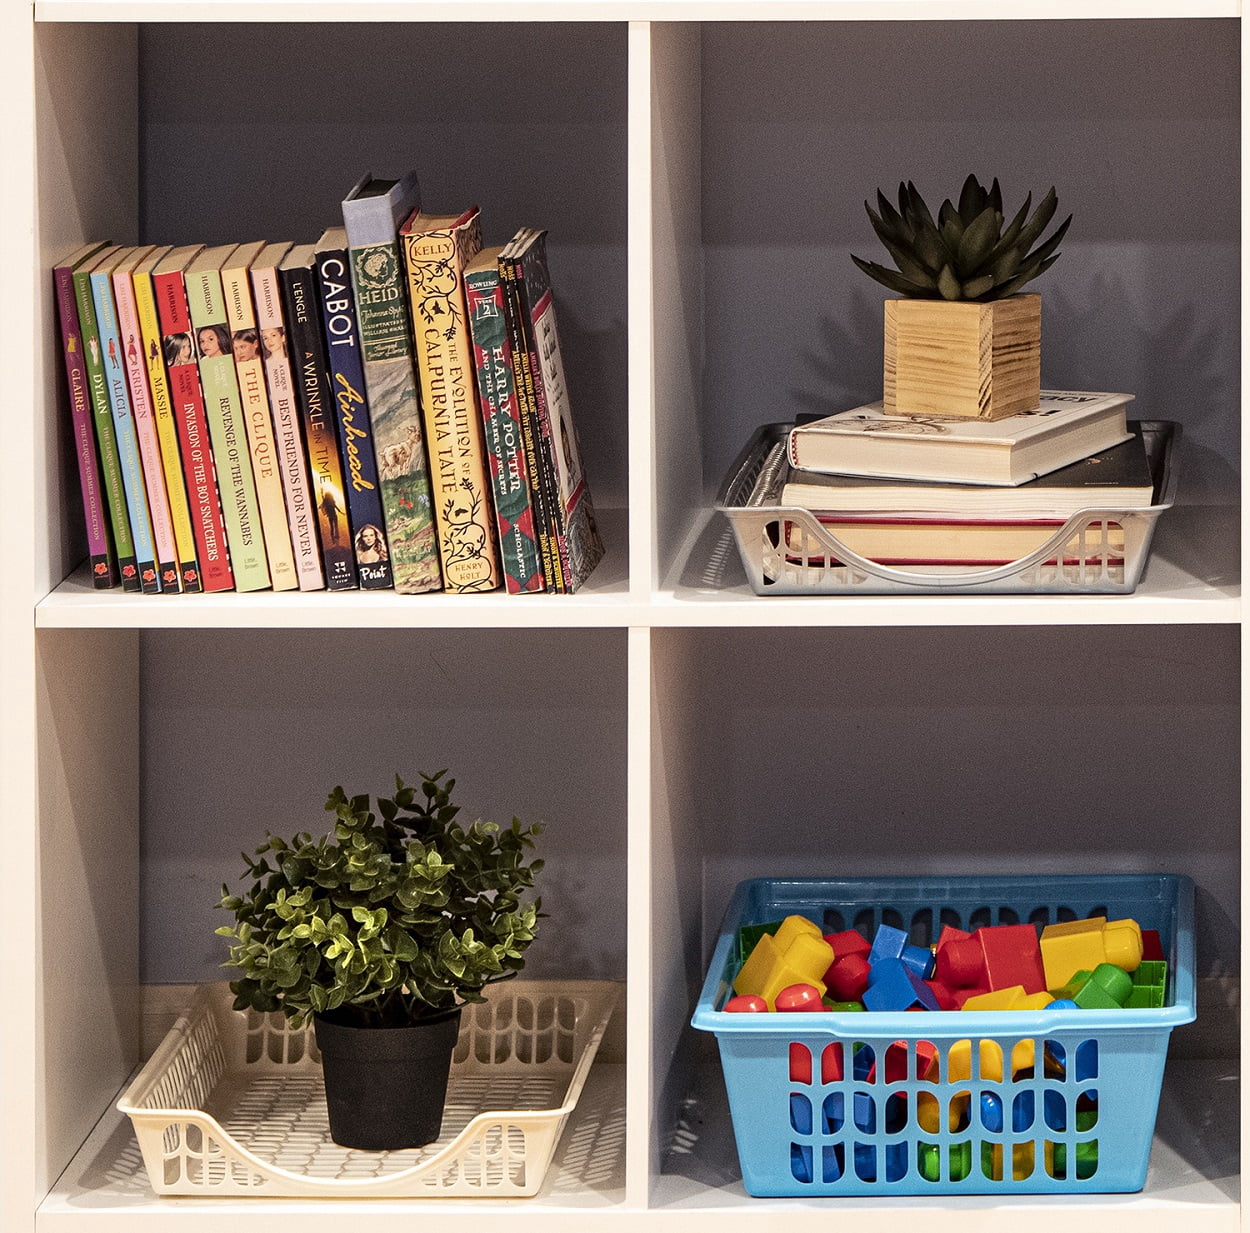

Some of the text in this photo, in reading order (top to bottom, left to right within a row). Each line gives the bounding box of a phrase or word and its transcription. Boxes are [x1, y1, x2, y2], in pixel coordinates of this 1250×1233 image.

[202, 276, 214, 315] HARRISON
[320, 259, 354, 347] CABOT
[71, 368, 84, 412] CLAIRE
[93, 374, 107, 414] DYLAN
[113, 379, 126, 419] ALICIA
[132, 368, 147, 419] KRISTEN
[154, 377, 168, 419] MASSIE
[492, 347, 521, 492] HARRY POTTER
[512, 523, 527, 579] SCHOLASTIC
